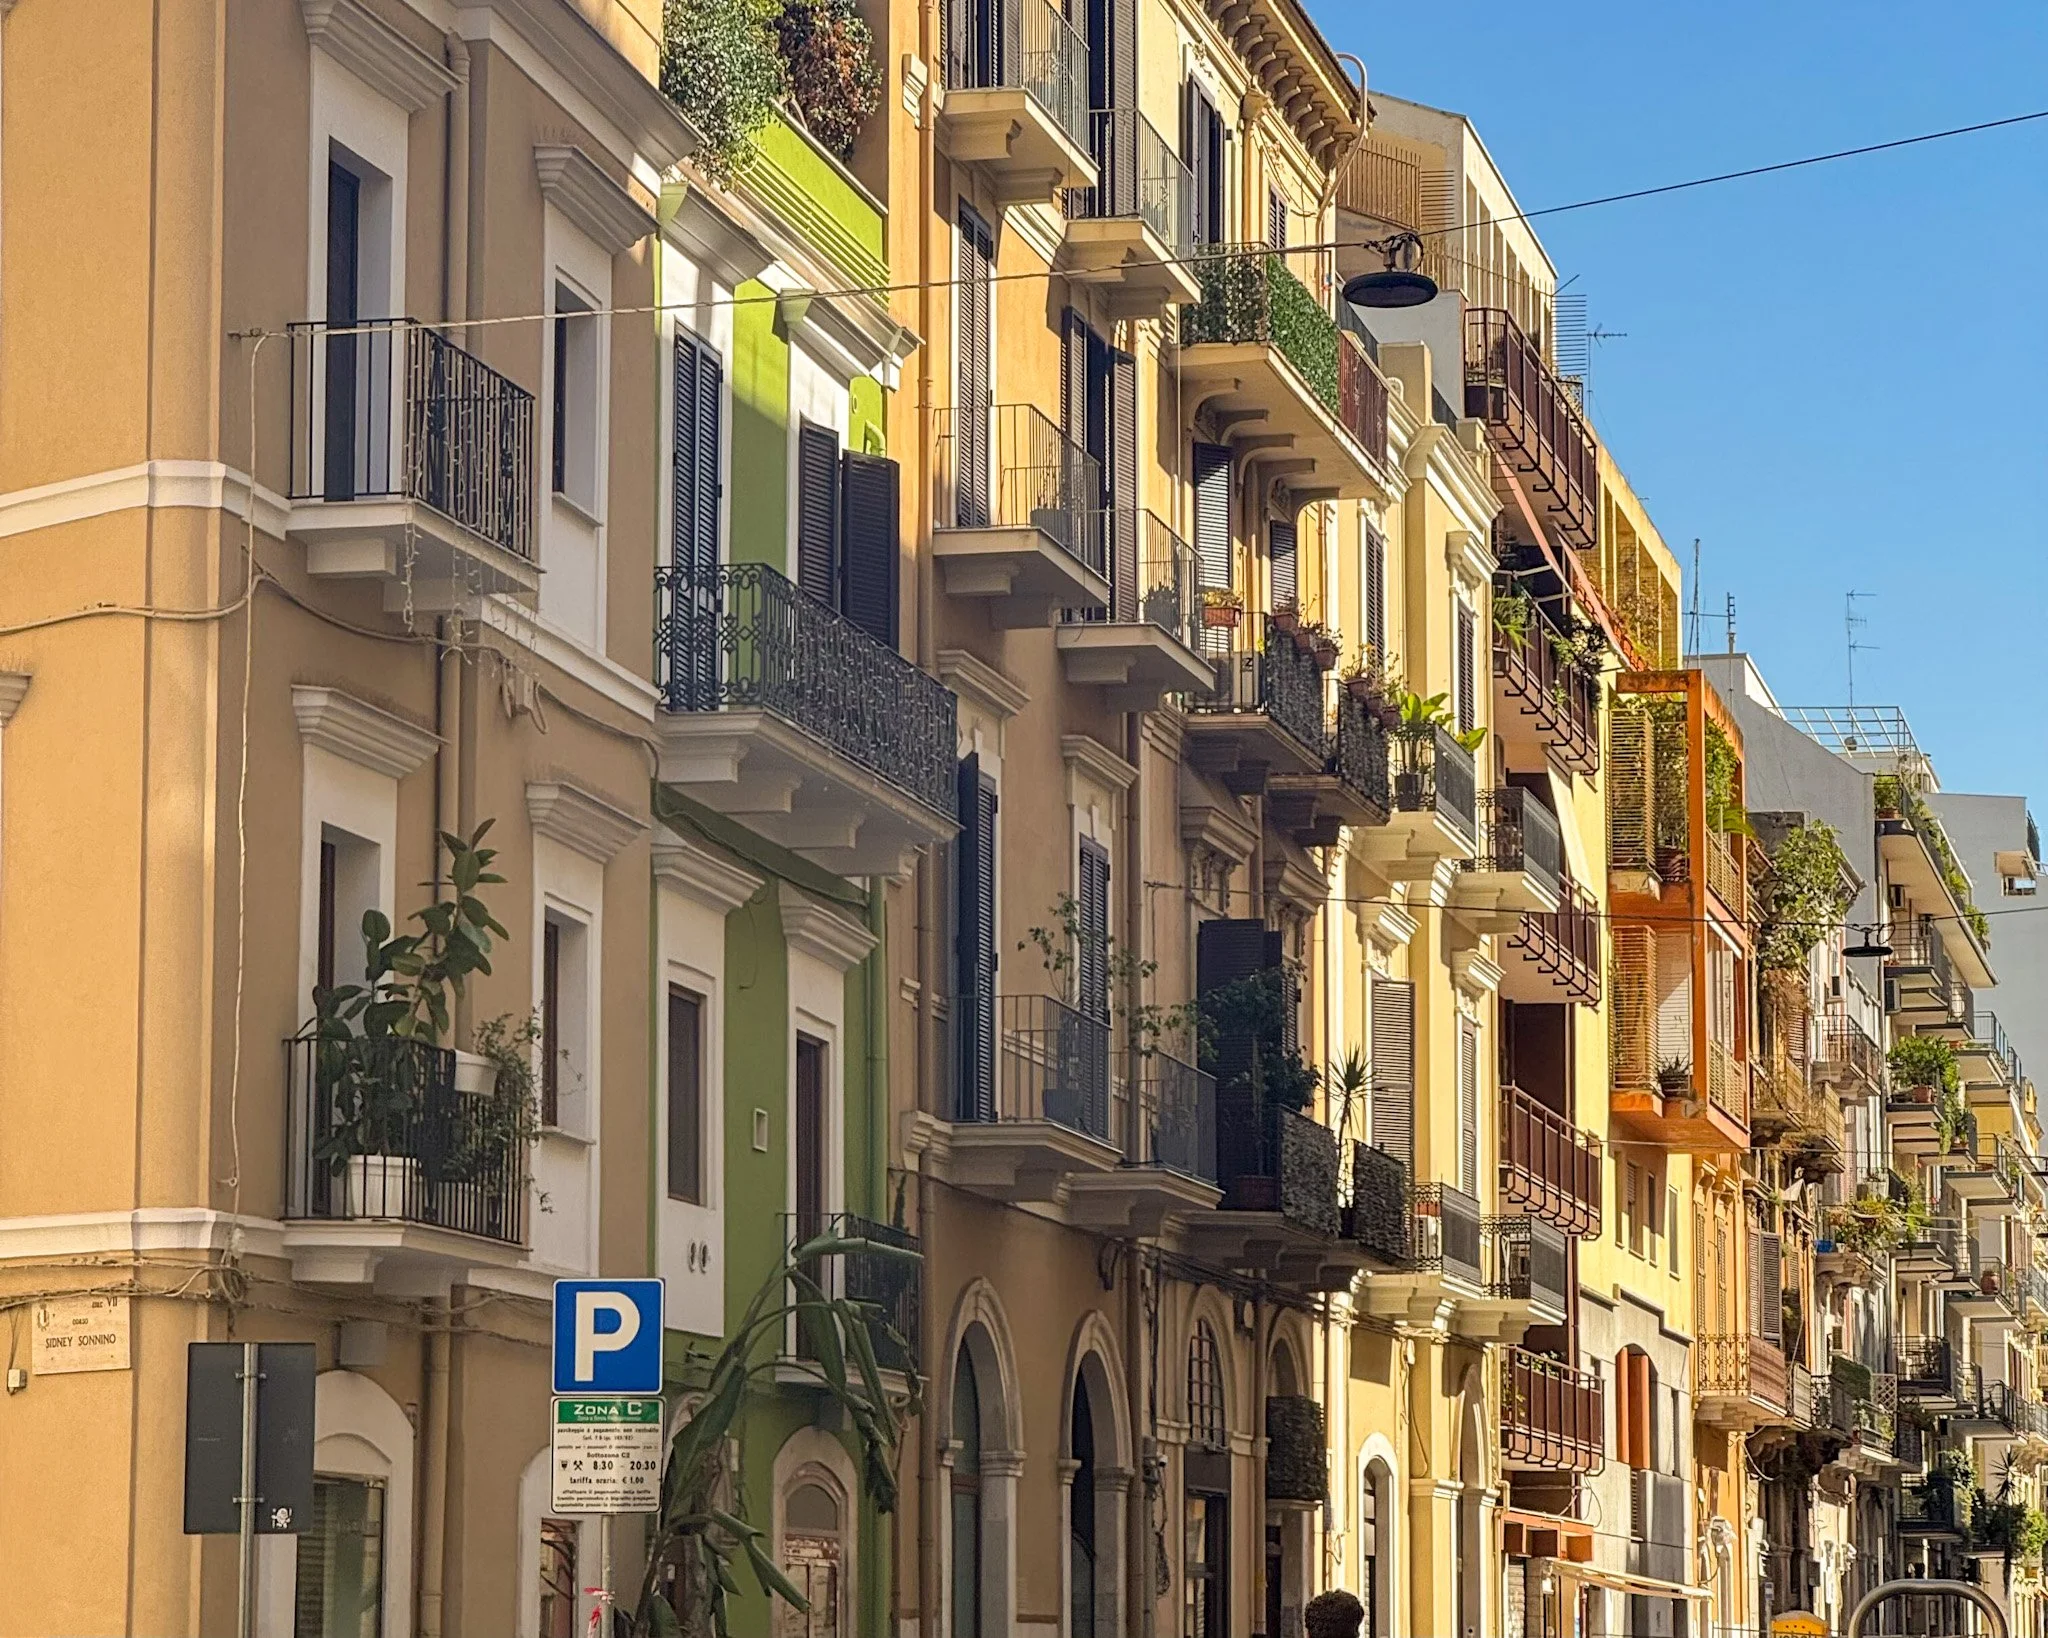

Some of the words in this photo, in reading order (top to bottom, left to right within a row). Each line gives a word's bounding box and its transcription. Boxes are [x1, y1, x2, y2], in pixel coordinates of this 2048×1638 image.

[45, 1337, 73, 1348] SIDNEY
[78, 1334, 116, 1346] SONNINO
[575, 1291, 640, 1382] P
[627, 1402, 642, 1416] C
[570, 1476, 592, 1485] tariffa
